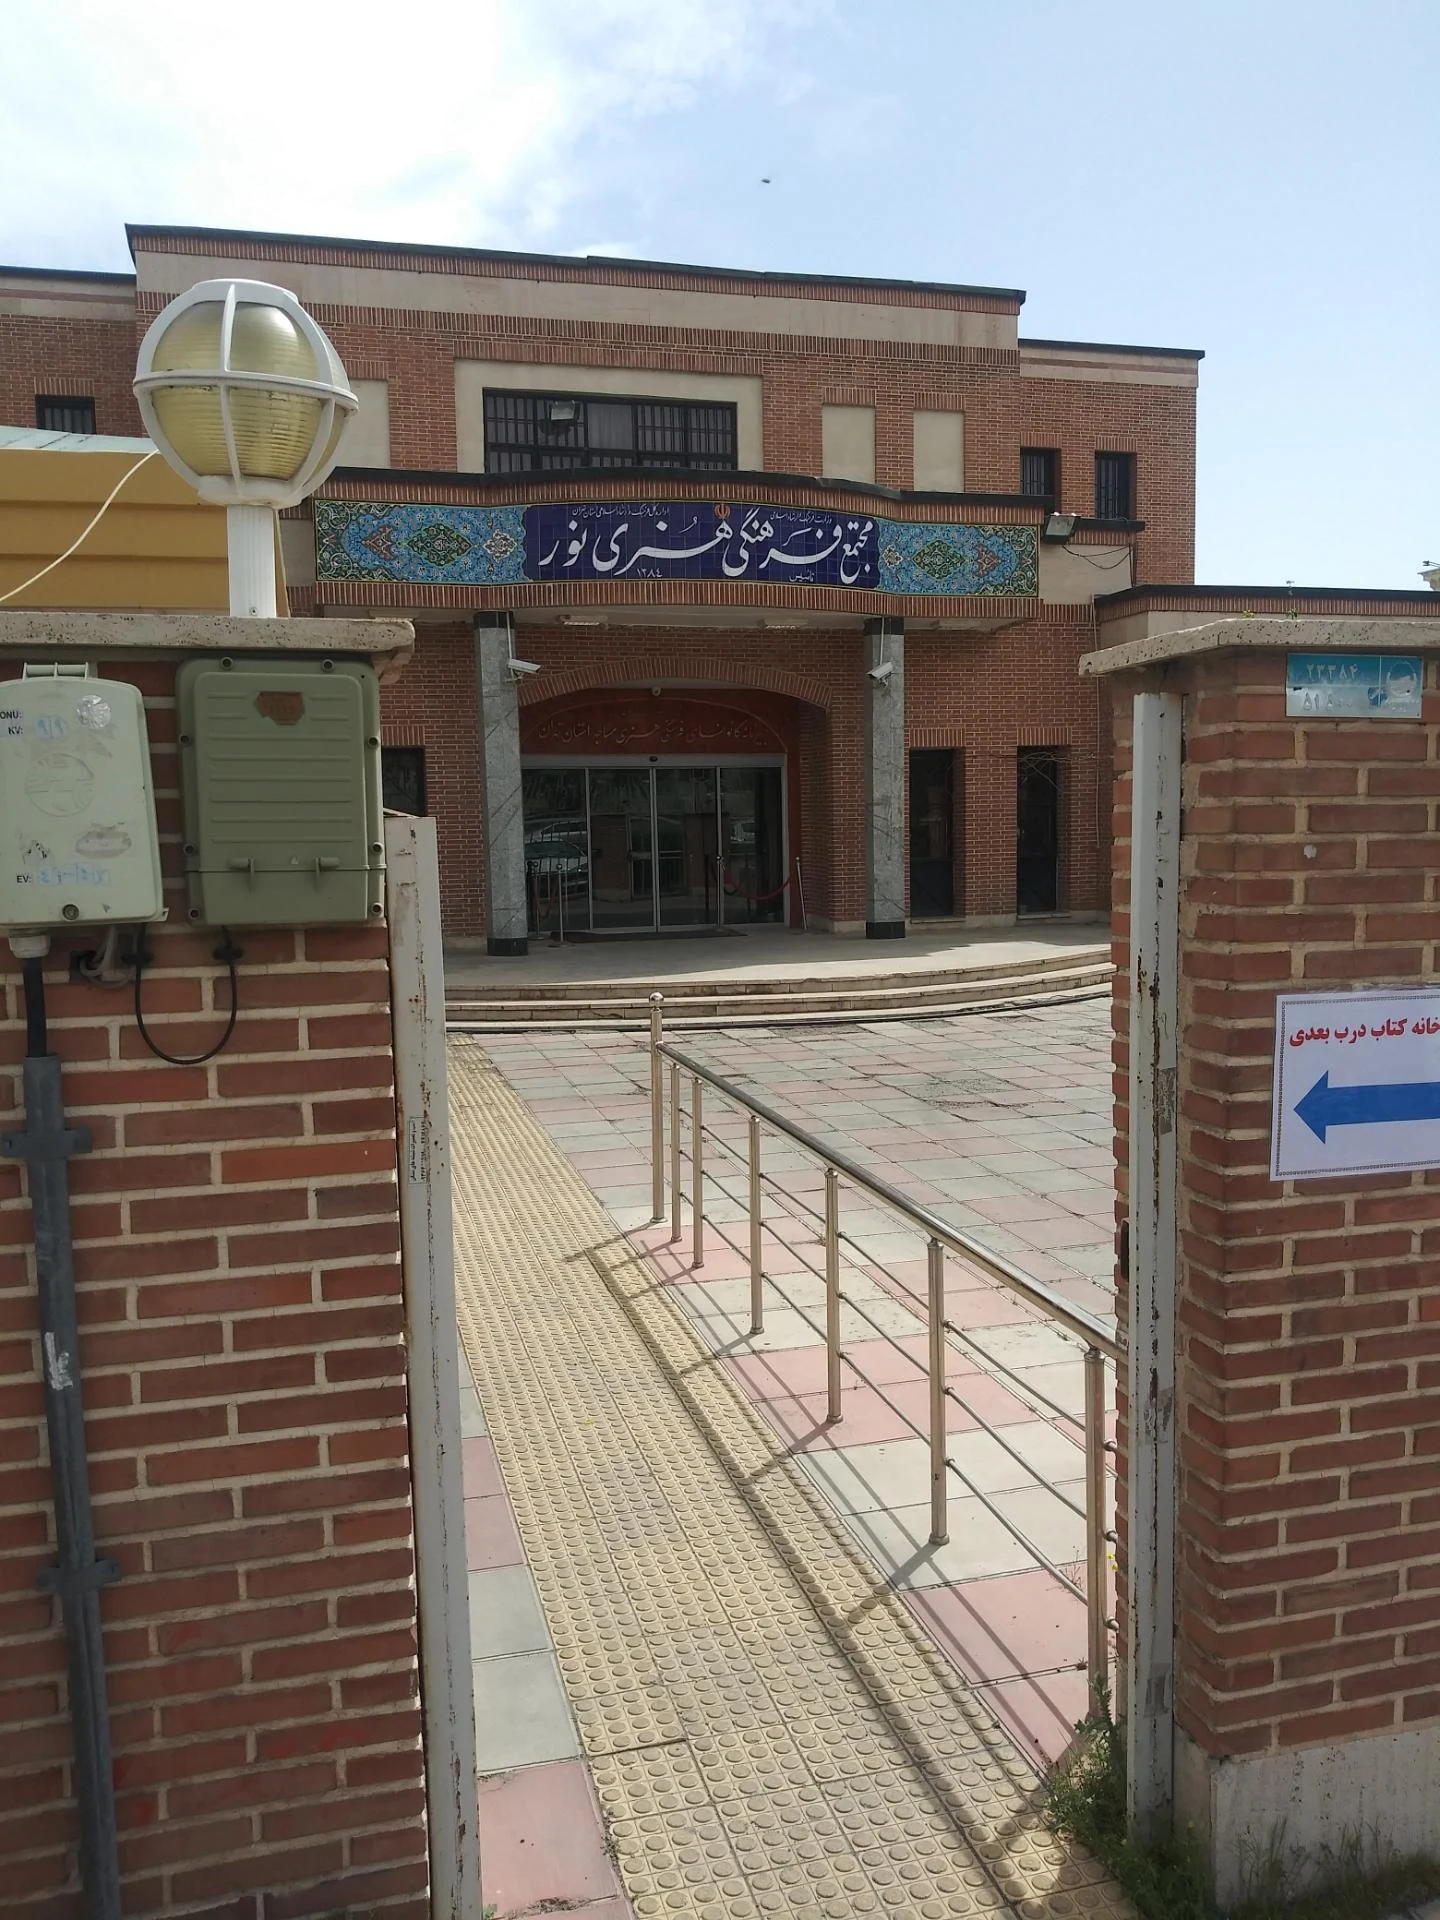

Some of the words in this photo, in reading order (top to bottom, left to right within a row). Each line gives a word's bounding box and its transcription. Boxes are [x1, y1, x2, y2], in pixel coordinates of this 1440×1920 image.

[814, 514, 832, 524] وزارت
[538, 520, 588, 567] نور
[592, 516, 733, 576] هنری
[722, 507, 843, 578] فرهنگی
[840, 520, 874, 585] مجتمع
[562, 720, 590, 743] استان
[614, 723, 661, 744] هنری
[1290, 1026, 1330, 1047] بعدی
[1334, 1024, 1366, 1044] درب
[1371, 1018, 1408, 1041] کتاب
